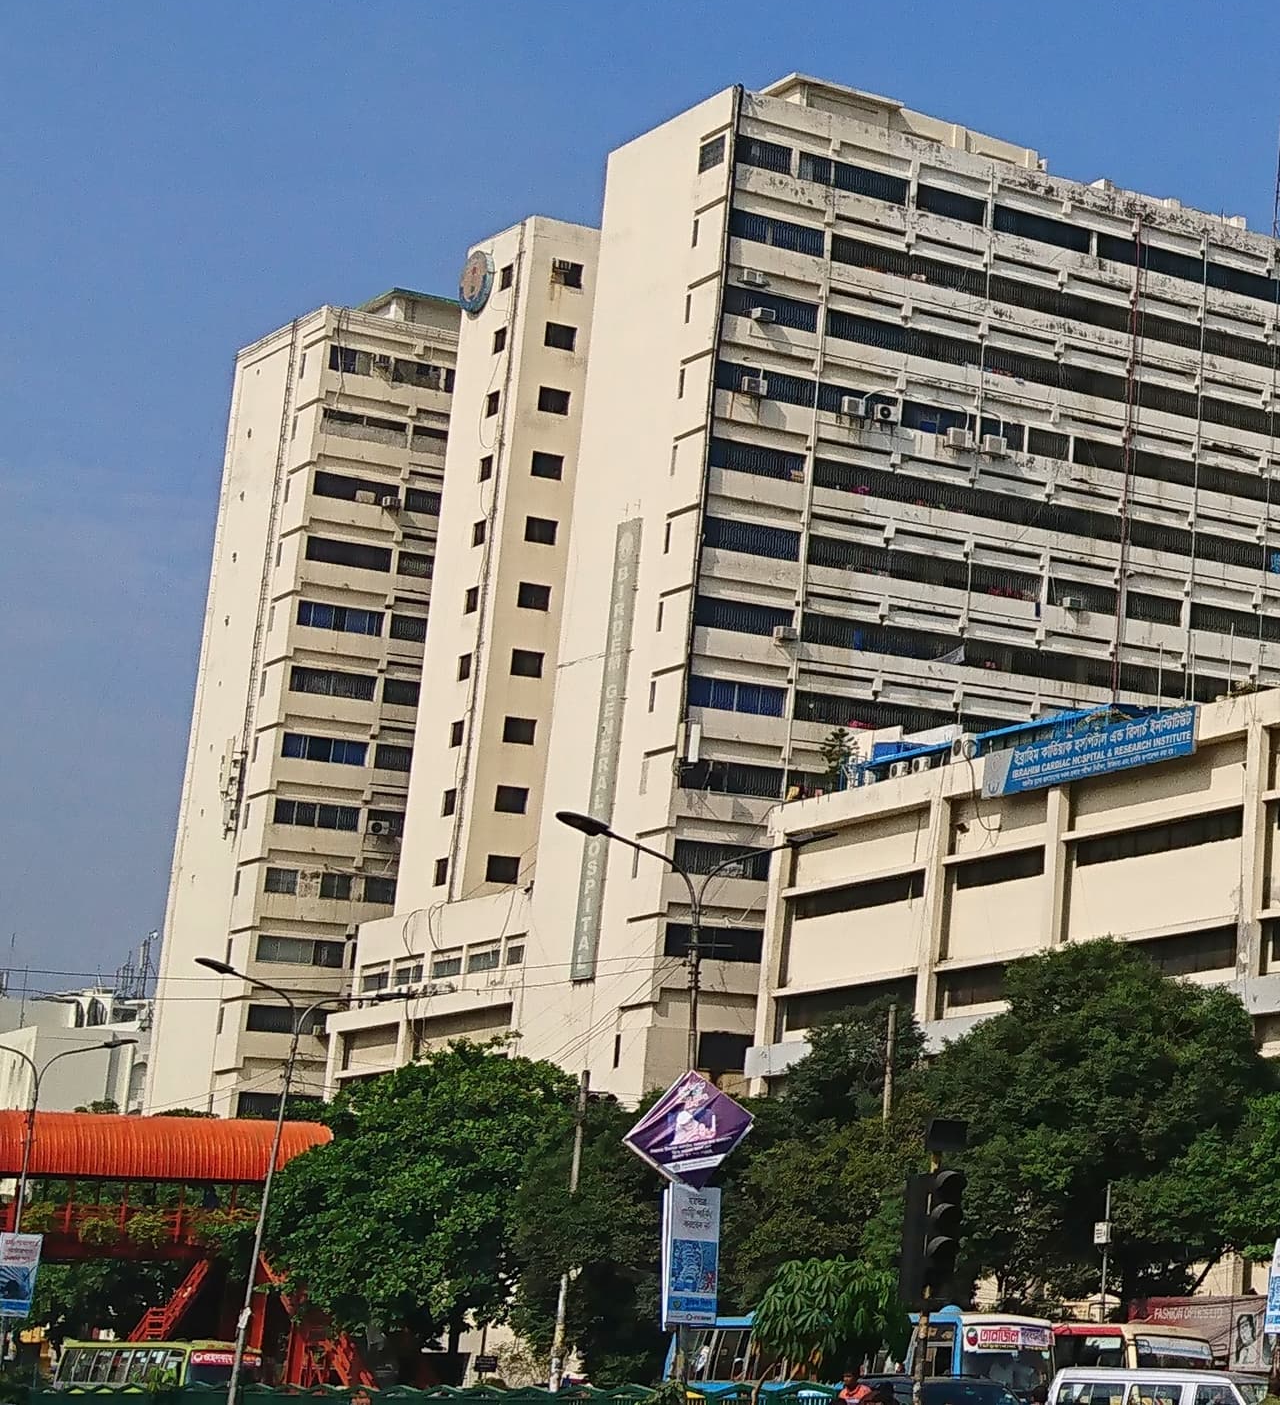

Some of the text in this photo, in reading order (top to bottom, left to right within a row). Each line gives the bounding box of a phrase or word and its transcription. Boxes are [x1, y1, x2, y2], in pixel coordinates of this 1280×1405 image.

[607, 565, 630, 672] BIRDEM
[594, 684, 618, 811] GENERAL
[1012, 765, 1040, 779] IBRAHIM
[1041, 758, 1071, 772] CARDIAC
[1072, 750, 1106, 766] HOSPITAL
[1107, 748, 1113, 757] &
[1114, 740, 1152, 756] RESEARCH
[1153, 731, 1192, 747] INSTITUTE
[576, 835, 601, 970] OSPITAL
